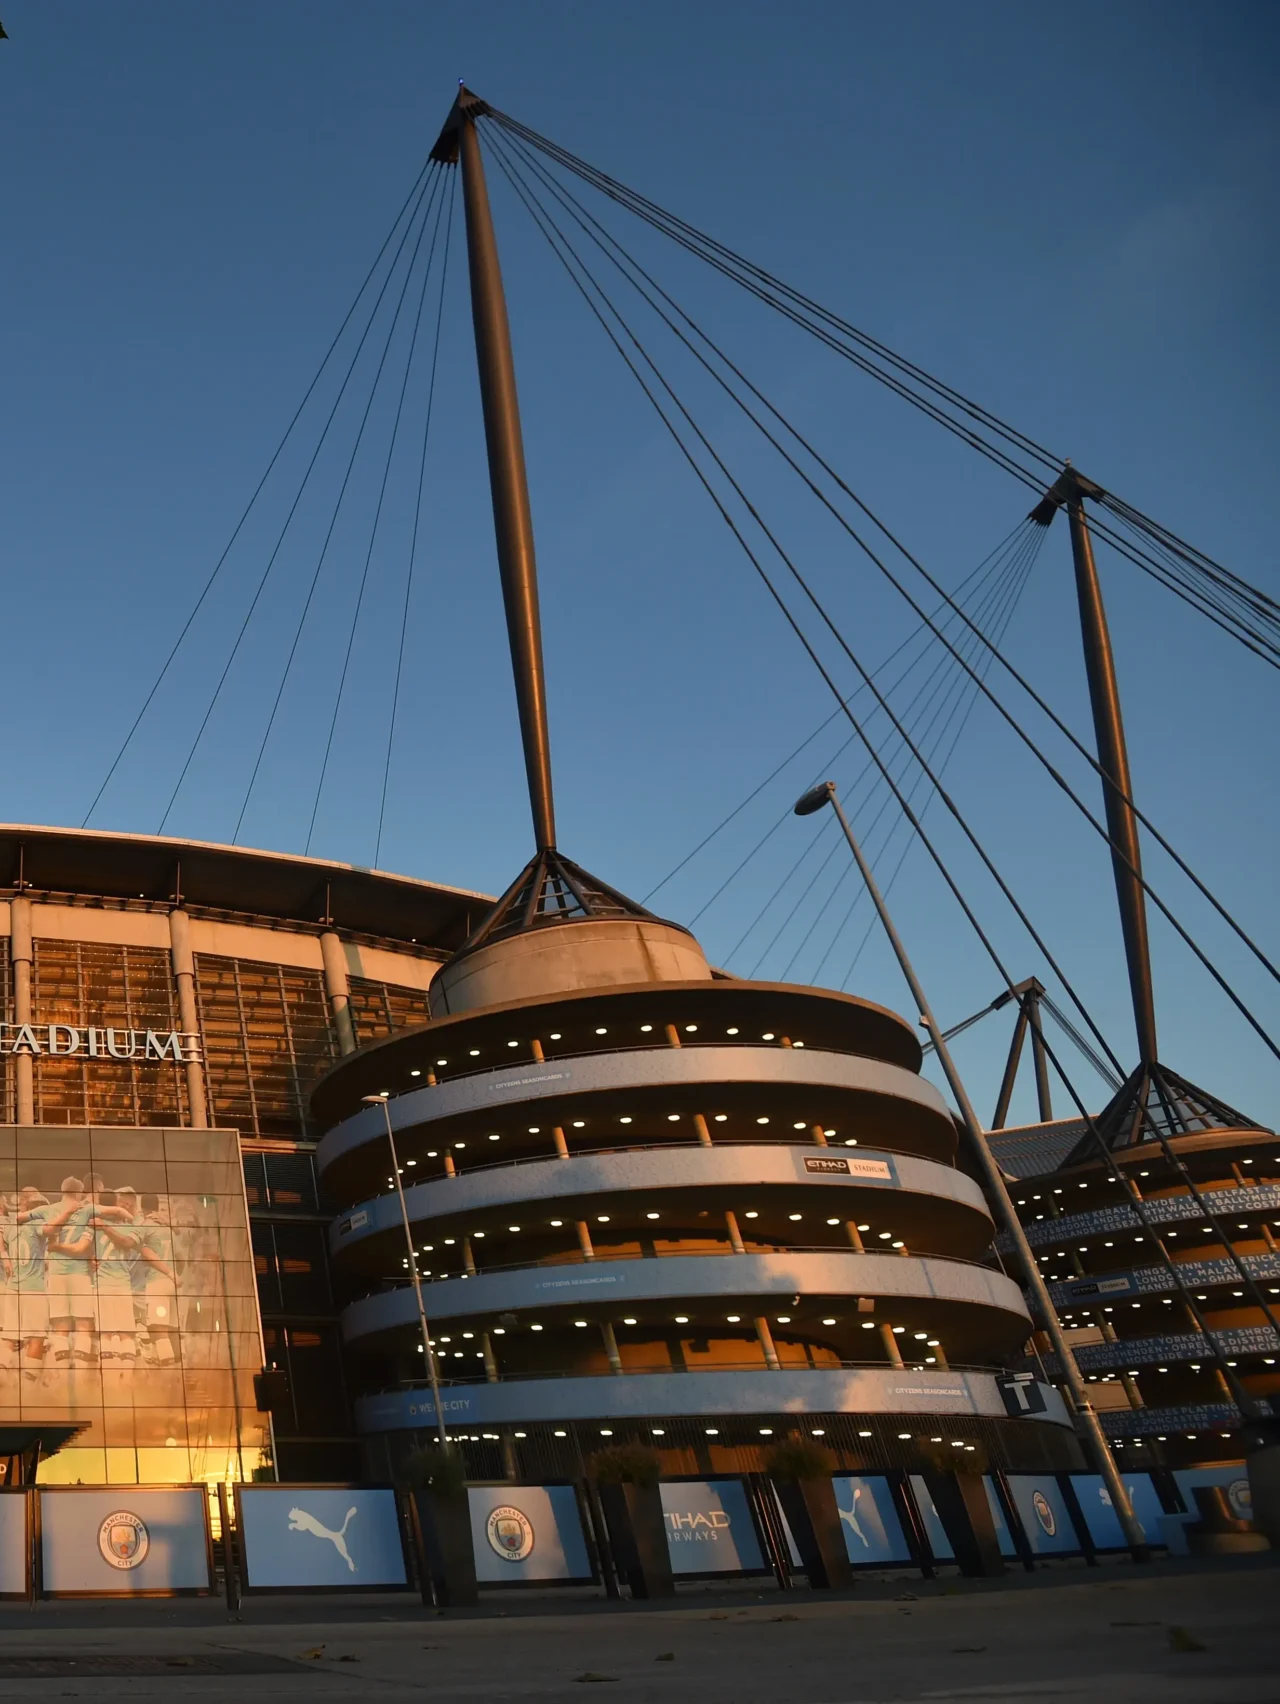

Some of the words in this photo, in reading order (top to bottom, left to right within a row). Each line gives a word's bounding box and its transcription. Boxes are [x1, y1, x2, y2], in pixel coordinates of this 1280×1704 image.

[807, 1160, 847, 1169] ETIHAD
[853, 1164, 886, 1173] STADIUM
[1145, 1198, 1176, 1208] HYDE
[1209, 1187, 1260, 1199] BELFAST
[1103, 1215, 1137, 1231] ESSEX
[1132, 1267, 1166, 1278] KINGS
[1197, 1263, 1259, 1276] MALAYIA
[1125, 1338, 1154, 1349] WEST
[1157, 1351, 1183, 1361] SIDE
[1004, 1380, 1031, 1410] T
[419, 1403, 432, 1412] WE
[450, 1400, 470, 1410] CITY
[103, 1515, 144, 1533] MANCHESTER
[490, 1510, 527, 1526] MANCHESTER
[668, 1531, 718, 1542] IRWAYS
